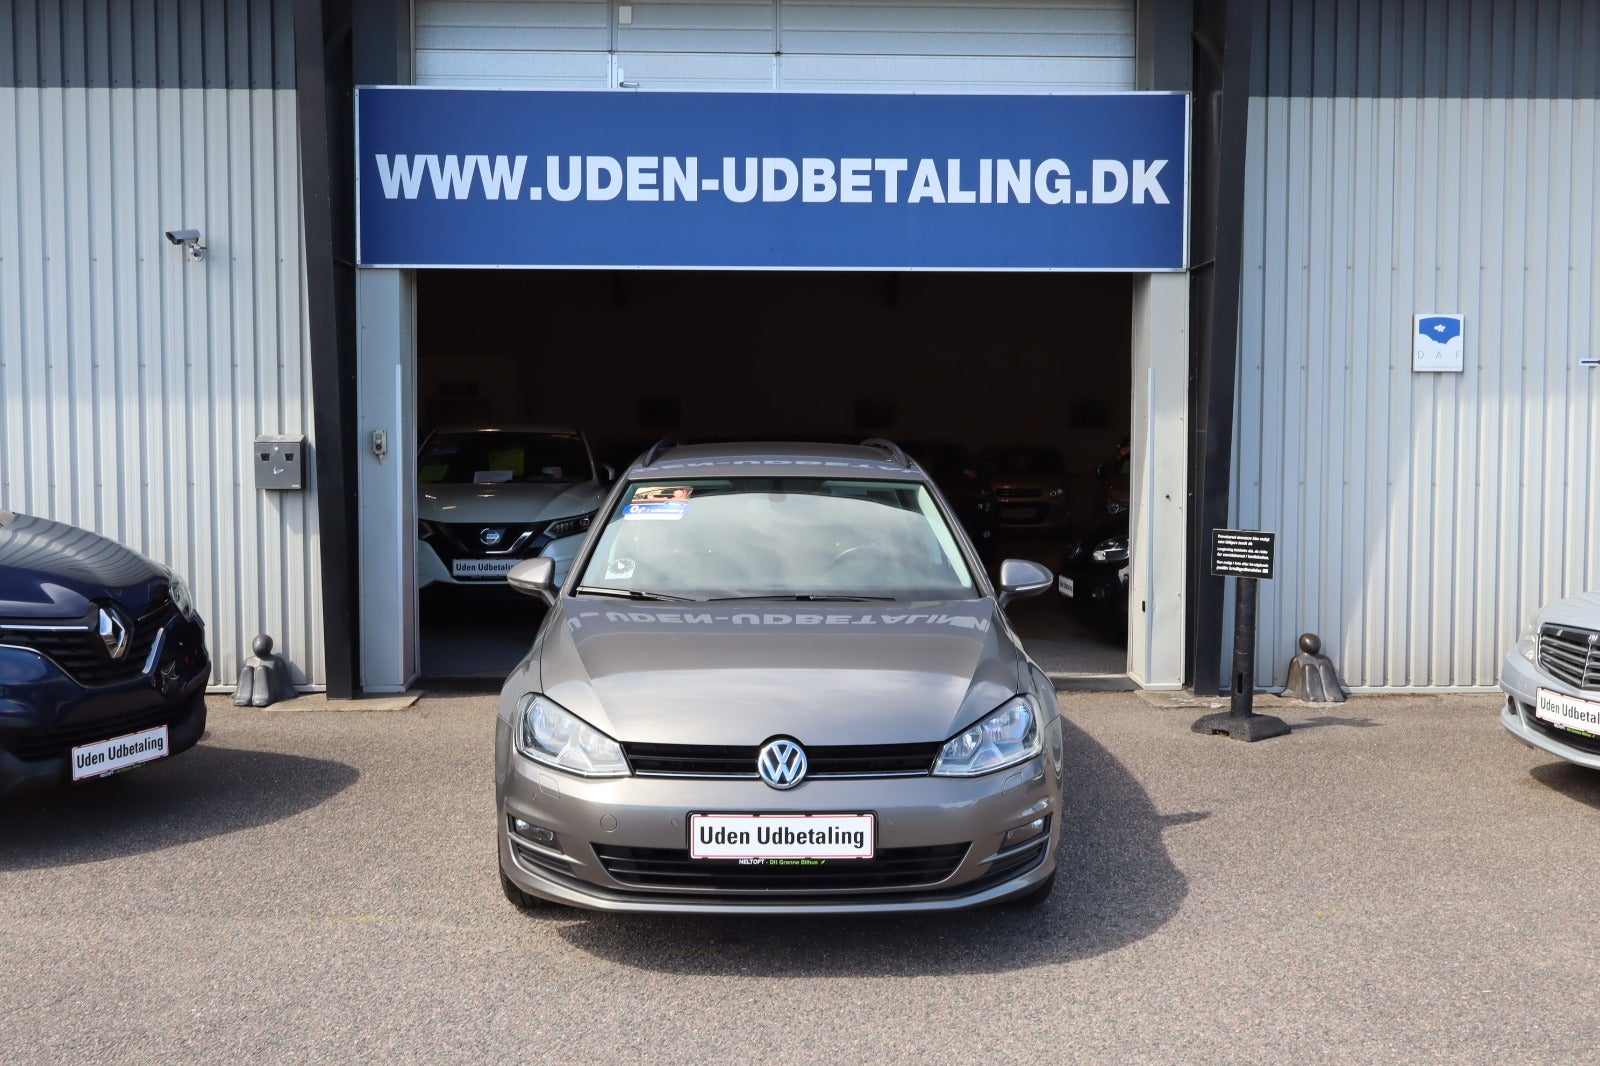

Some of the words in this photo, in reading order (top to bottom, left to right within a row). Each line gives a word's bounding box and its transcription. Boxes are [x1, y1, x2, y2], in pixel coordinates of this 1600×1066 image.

[375, 153, 1171, 206] WWW.UDEN-UDBETALING.DK
[456, 562, 476, 571] Uden
[1540, 696, 1560, 715] Uden
[76, 751, 105, 769] Uden
[108, 736, 164, 761] Udbetaling
[700, 826, 750, 845] Uden
[757, 826, 864, 849] Udbetaling
